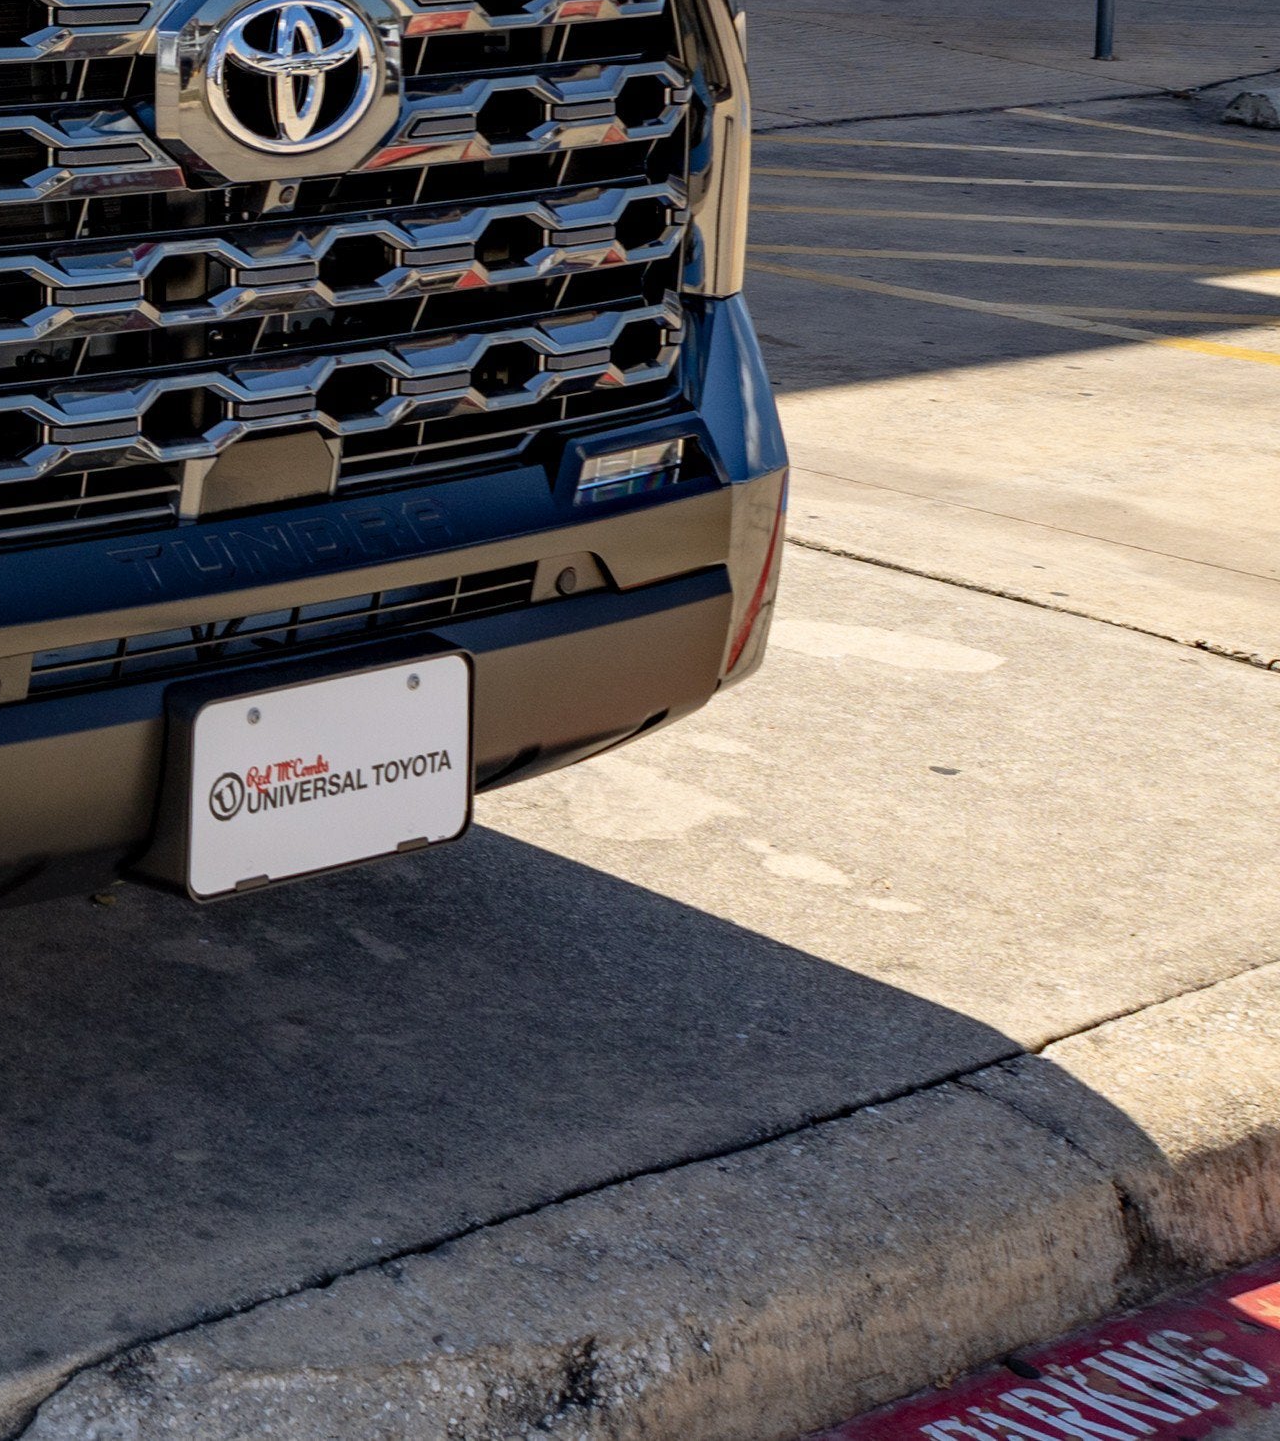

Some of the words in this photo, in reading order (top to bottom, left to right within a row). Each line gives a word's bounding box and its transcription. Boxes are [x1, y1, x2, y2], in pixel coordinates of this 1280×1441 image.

[106, 497, 458, 591] TUNDRA
[246, 765, 272, 793] Red
[274, 754, 329, 781] McCombs
[247, 768, 367, 813] UNIVERSAL
[372, 750, 452, 785] TOYOTA
